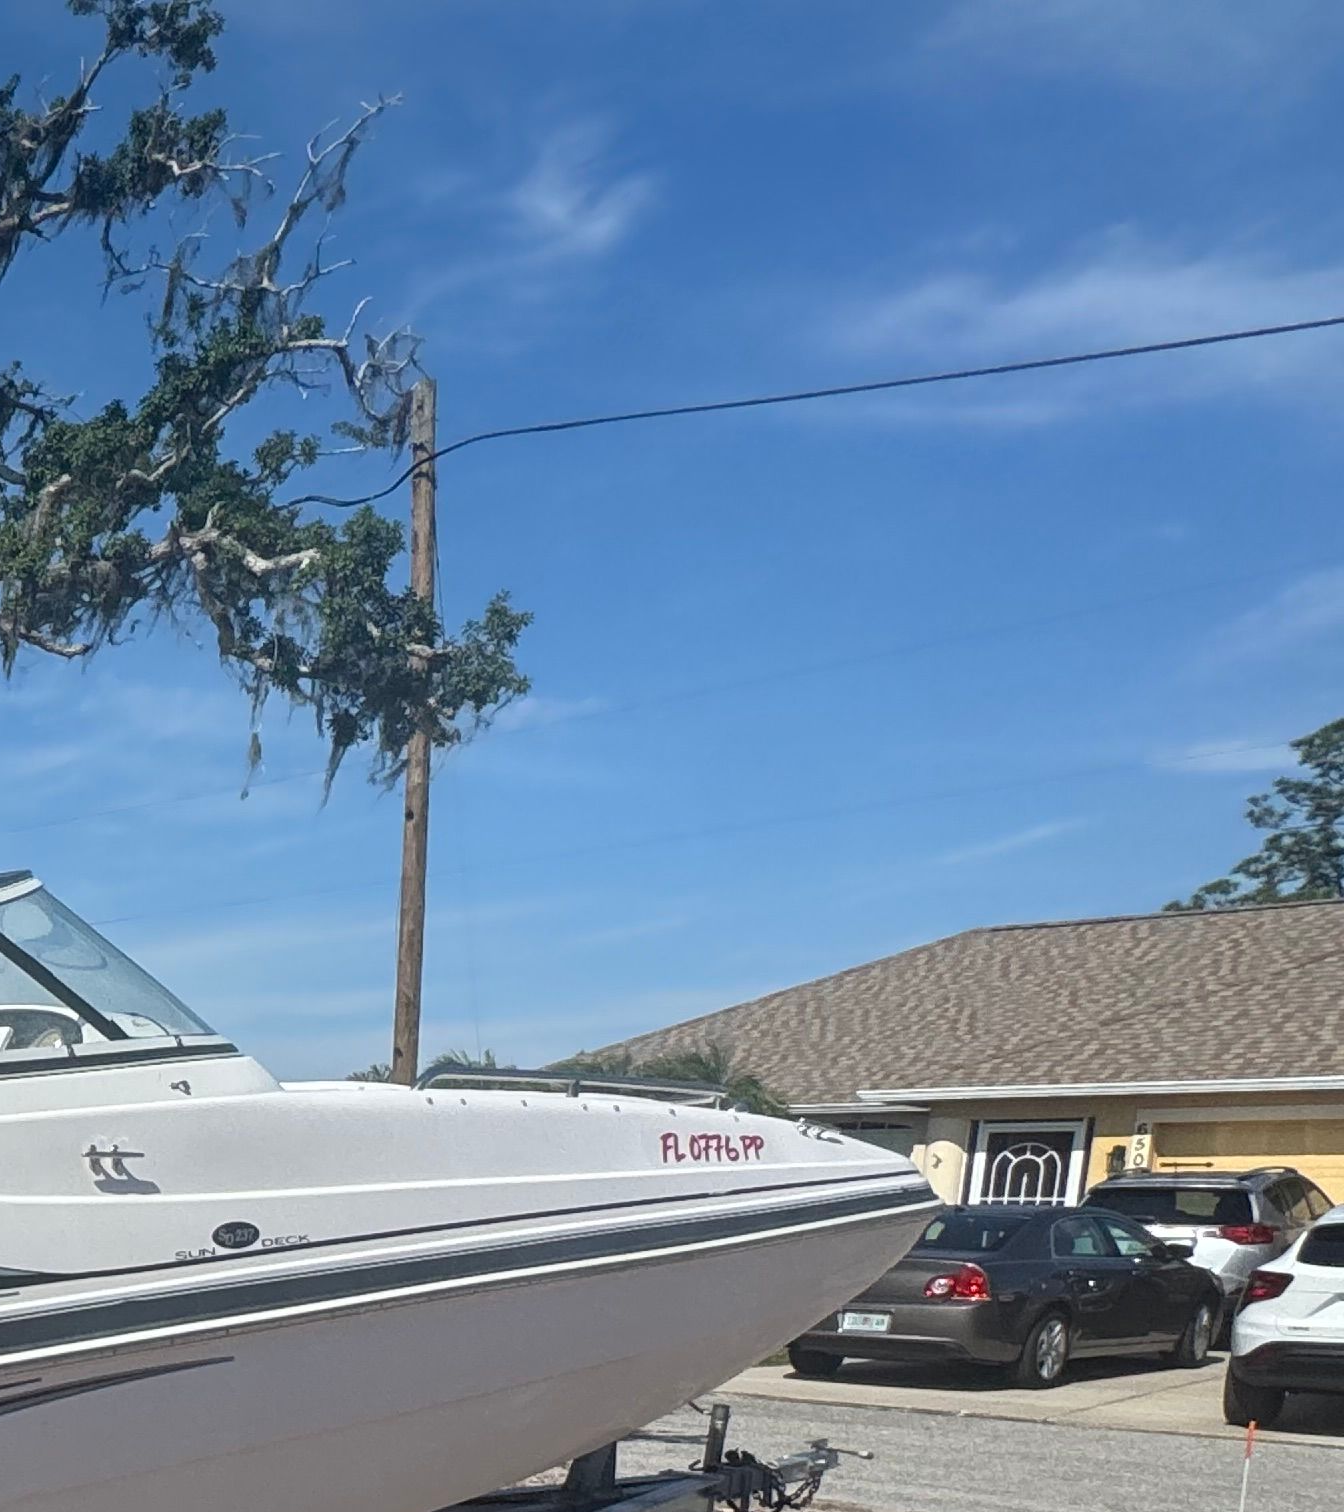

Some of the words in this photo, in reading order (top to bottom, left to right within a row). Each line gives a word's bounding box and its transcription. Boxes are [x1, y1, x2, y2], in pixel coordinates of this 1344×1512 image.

[660, 1132, 686, 1163] FL
[740, 1135, 764, 1160] PP
[175, 1246, 216, 1261] SUN
[261, 1234, 310, 1248] DECK
